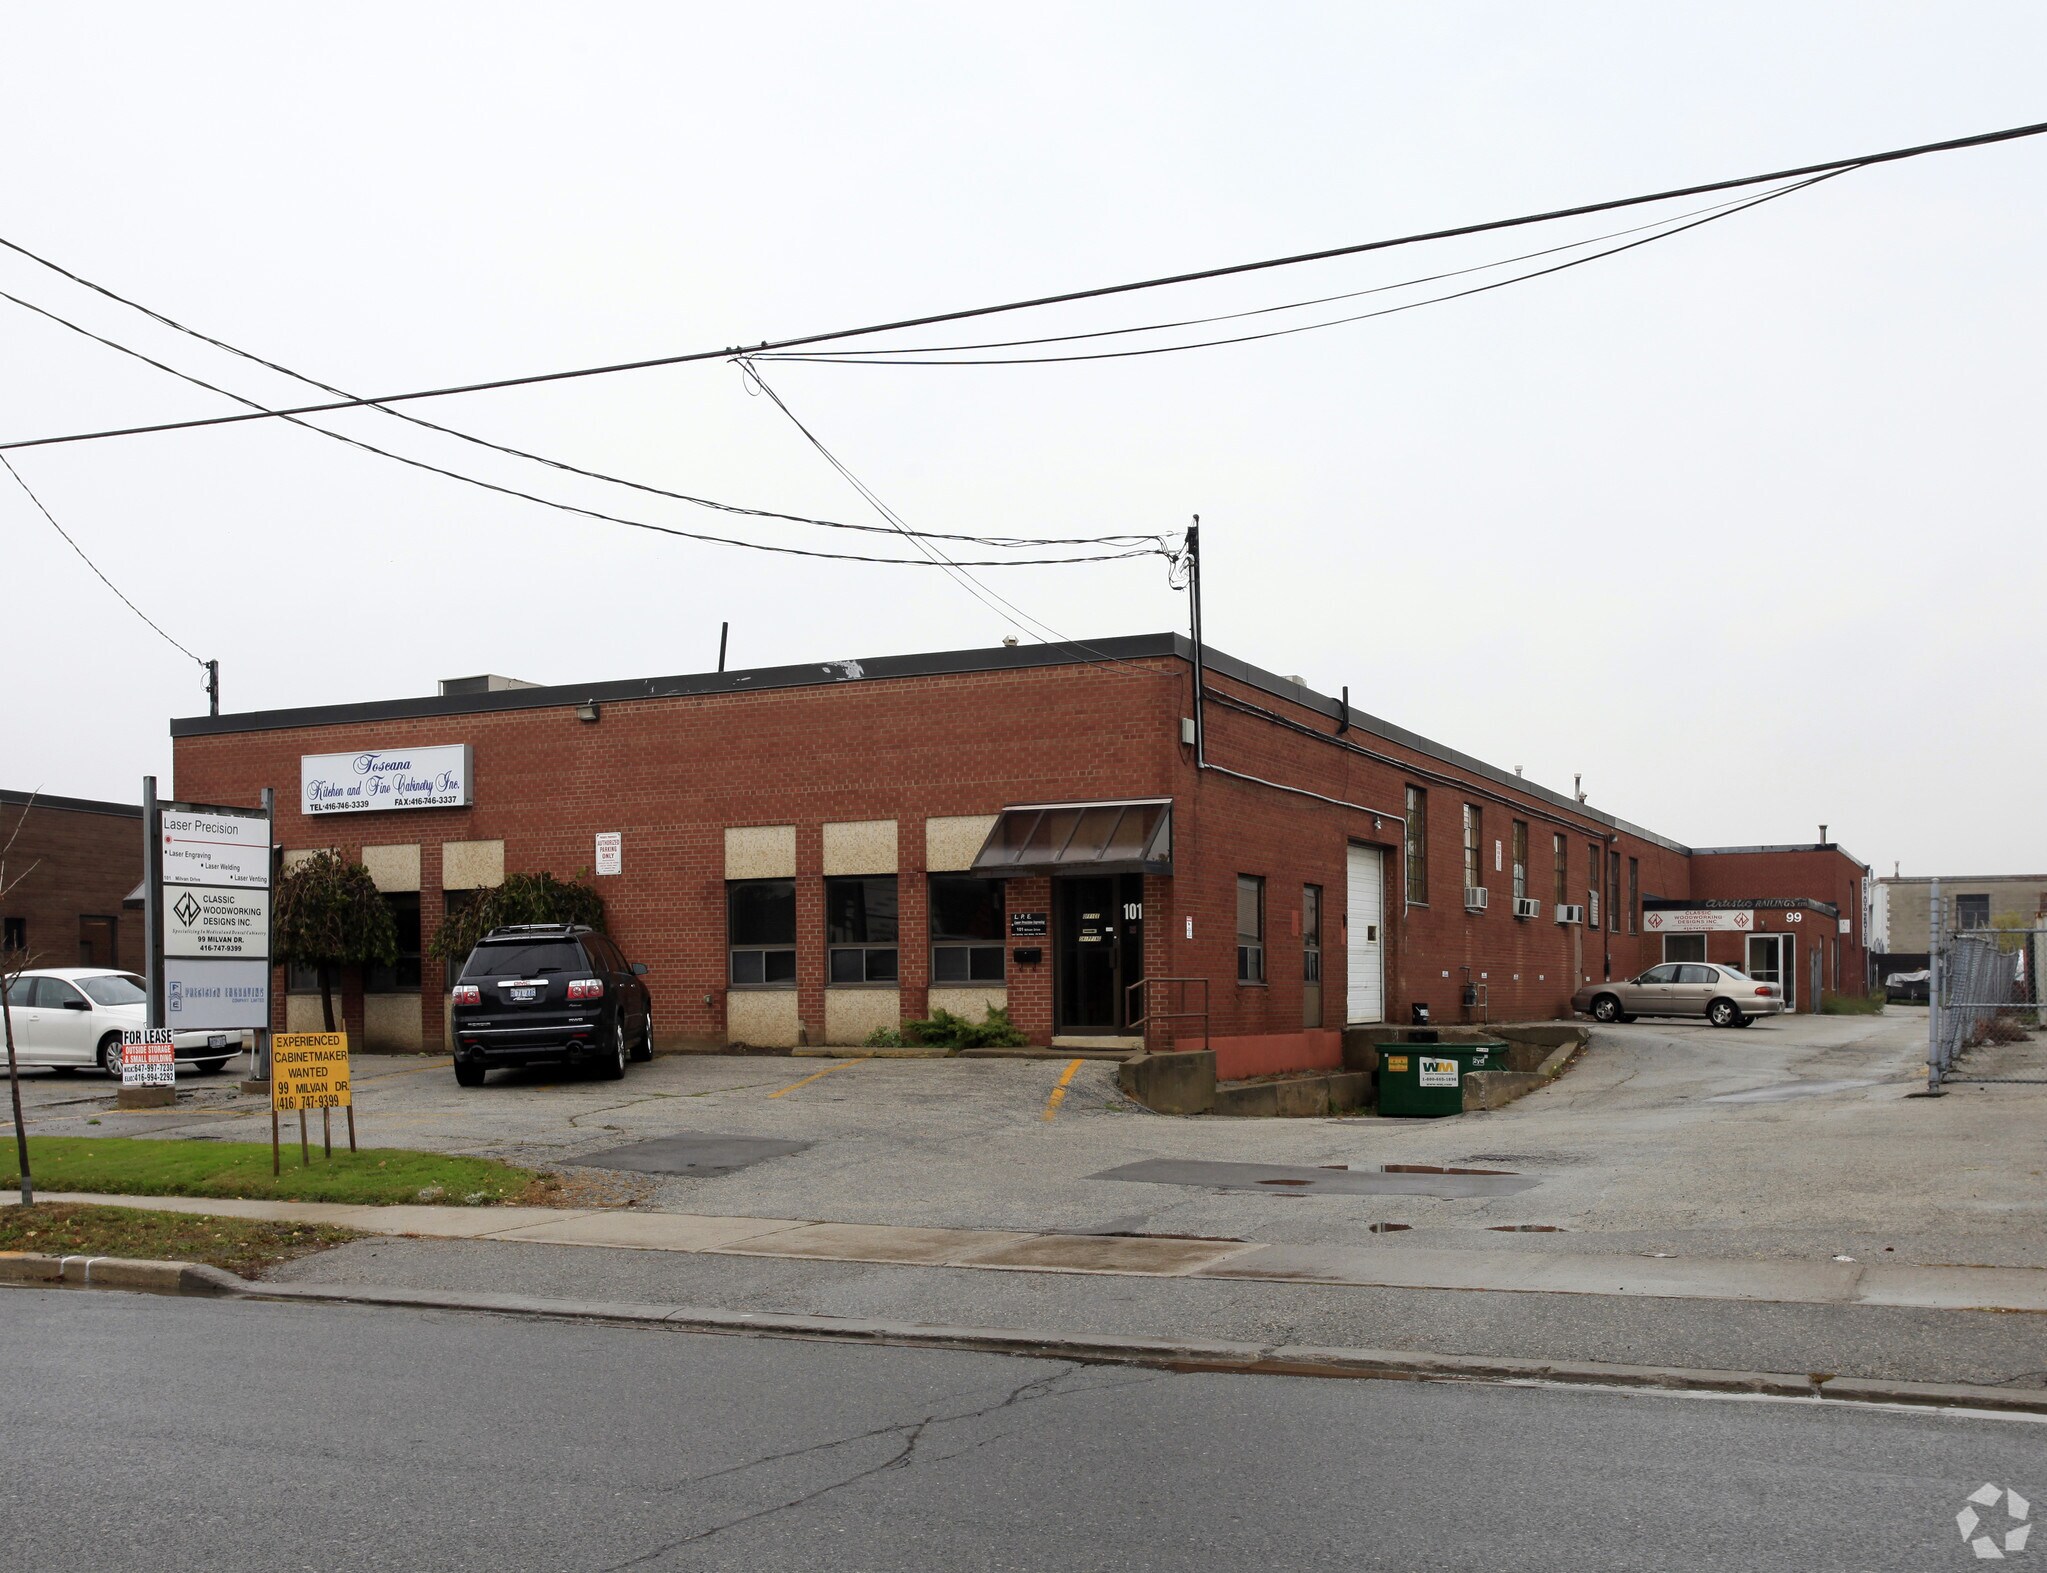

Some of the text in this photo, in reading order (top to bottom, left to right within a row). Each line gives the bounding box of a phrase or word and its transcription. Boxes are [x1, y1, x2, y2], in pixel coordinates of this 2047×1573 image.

[353, 754, 412, 775] Toscana
[306, 770, 460, 801] Kitchen and Fine Cabinetry Inc.
[164, 818, 238, 835] Laser Precision
[185, 851, 212, 860] Engraving
[205, 862, 240, 872] Laser Welding
[249, 876, 267, 884] Venting
[203, 895, 235, 904] CLASSIC
[203, 906, 261, 916] WOODWORKING
[1123, 903, 1142, 920] 101
[204, 918, 252, 926] DESIGNS INC.
[1786, 912, 1802, 923] 99
[124, 1030, 172, 1044] FOR LEASE
[277, 1035, 339, 1047] EXPERIENCED
[126, 1045, 171, 1054] OUTSIDE STORAGE
[130, 1055, 147, 1063] SMALL
[149, 1054, 172, 1062] BUILDING
[274, 1051, 347, 1063] CABINETMAKER
[288, 1067, 328, 1078] WANTED
[1423, 1062, 1454, 1072] WM
[278, 1081, 349, 1094] 99 MILVAN DR.
[277, 1095, 338, 1110] (416) 747-9399
